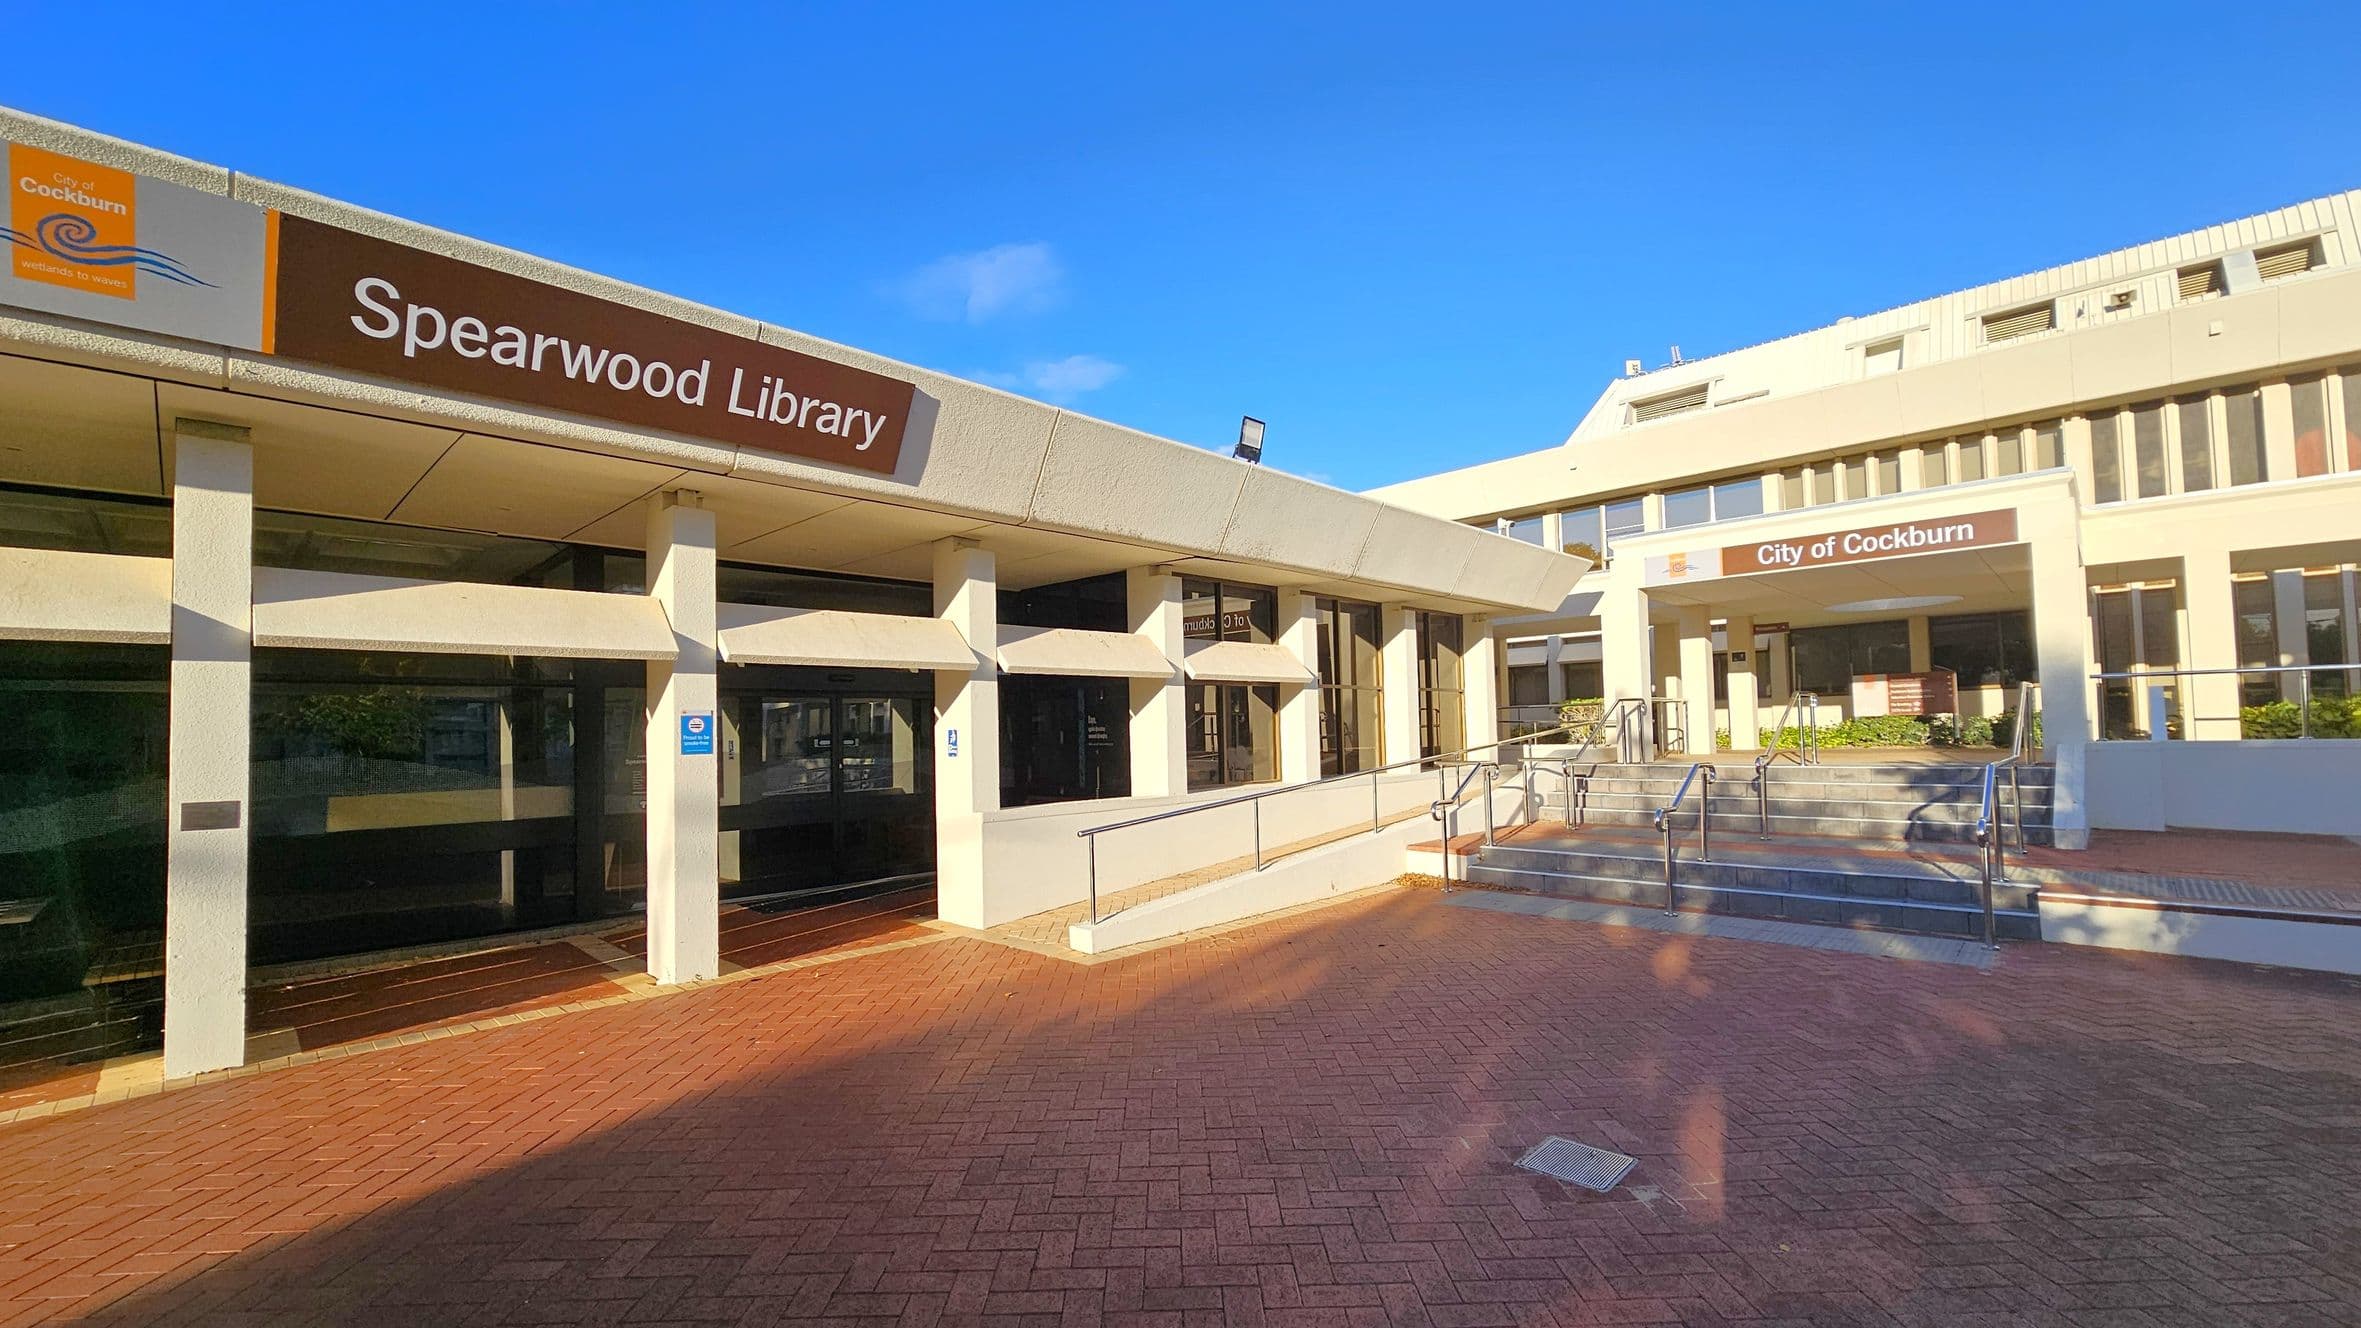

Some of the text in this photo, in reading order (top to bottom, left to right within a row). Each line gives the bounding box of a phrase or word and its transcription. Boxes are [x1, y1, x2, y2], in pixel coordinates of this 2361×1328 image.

[20, 176, 127, 215] Cockburn
[53, 172, 95, 191] City of
[21, 259, 128, 289] wetlands to waves
[350, 276, 887, 451] Spearwood Library
[1757, 522, 1974, 566] City of Cockburn
